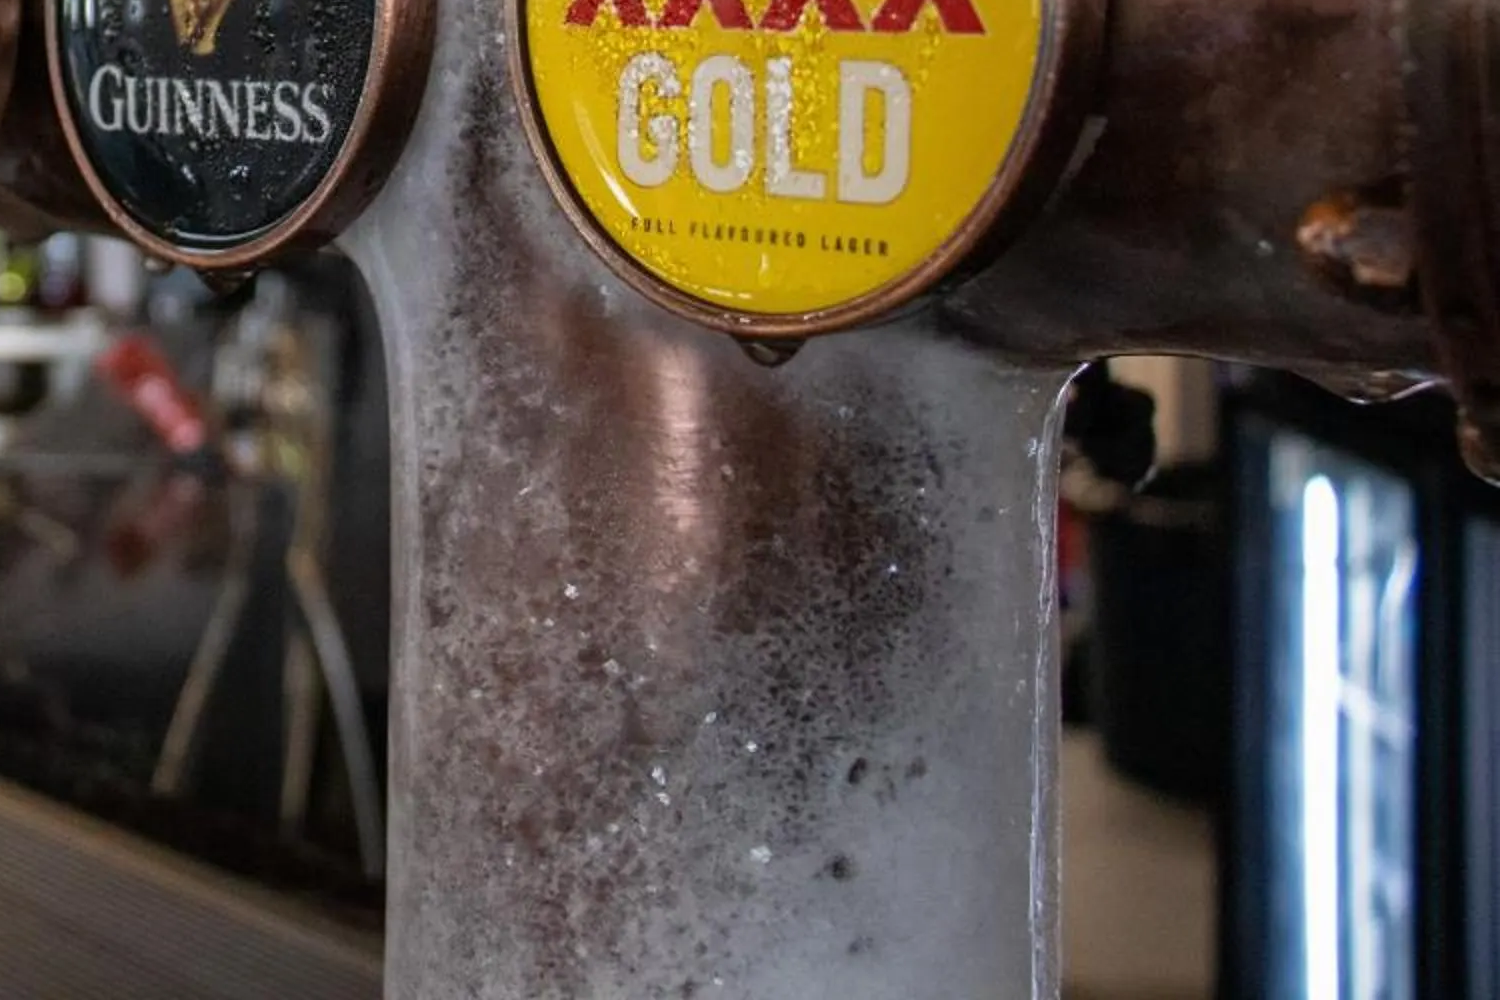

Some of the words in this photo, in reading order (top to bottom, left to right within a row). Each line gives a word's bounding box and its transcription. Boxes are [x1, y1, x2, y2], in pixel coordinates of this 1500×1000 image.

[88, 62, 332, 145] GUINNESS
[616, 51, 913, 205] GOLD
[631, 216, 677, 235] FULL
[690, 220, 806, 249] FLAVOURED
[820, 234, 889, 257] LAGER
